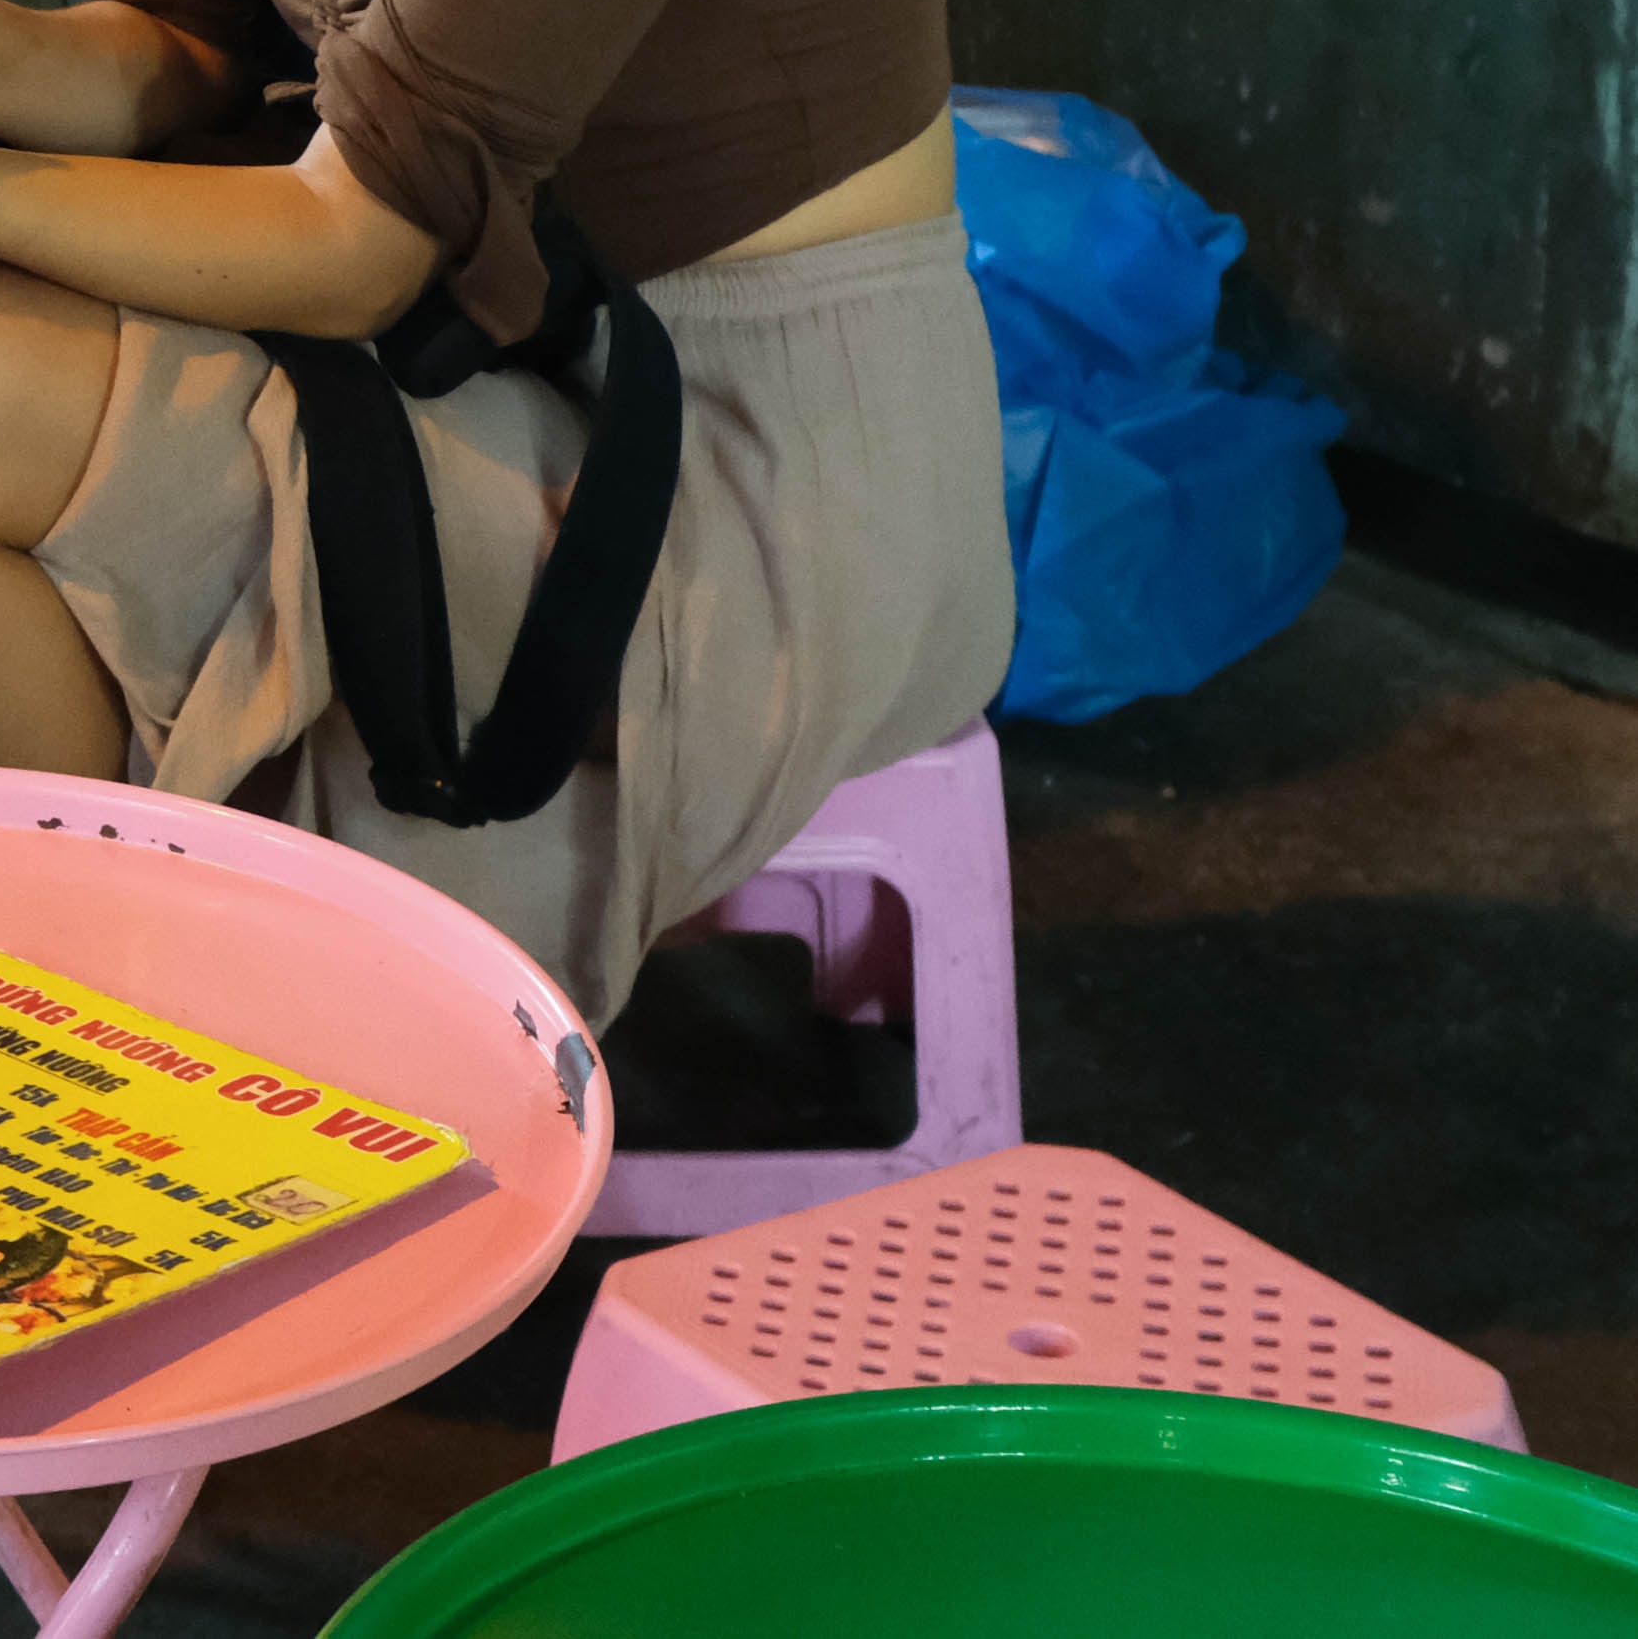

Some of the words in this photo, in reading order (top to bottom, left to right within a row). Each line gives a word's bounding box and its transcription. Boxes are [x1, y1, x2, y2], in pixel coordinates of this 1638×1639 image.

[68, 1019, 217, 1083] NƯỚNG
[217, 1073, 323, 1117] CÔ
[311, 1107, 440, 1163] VUI
[34, 1206, 95, 1231] MAI
